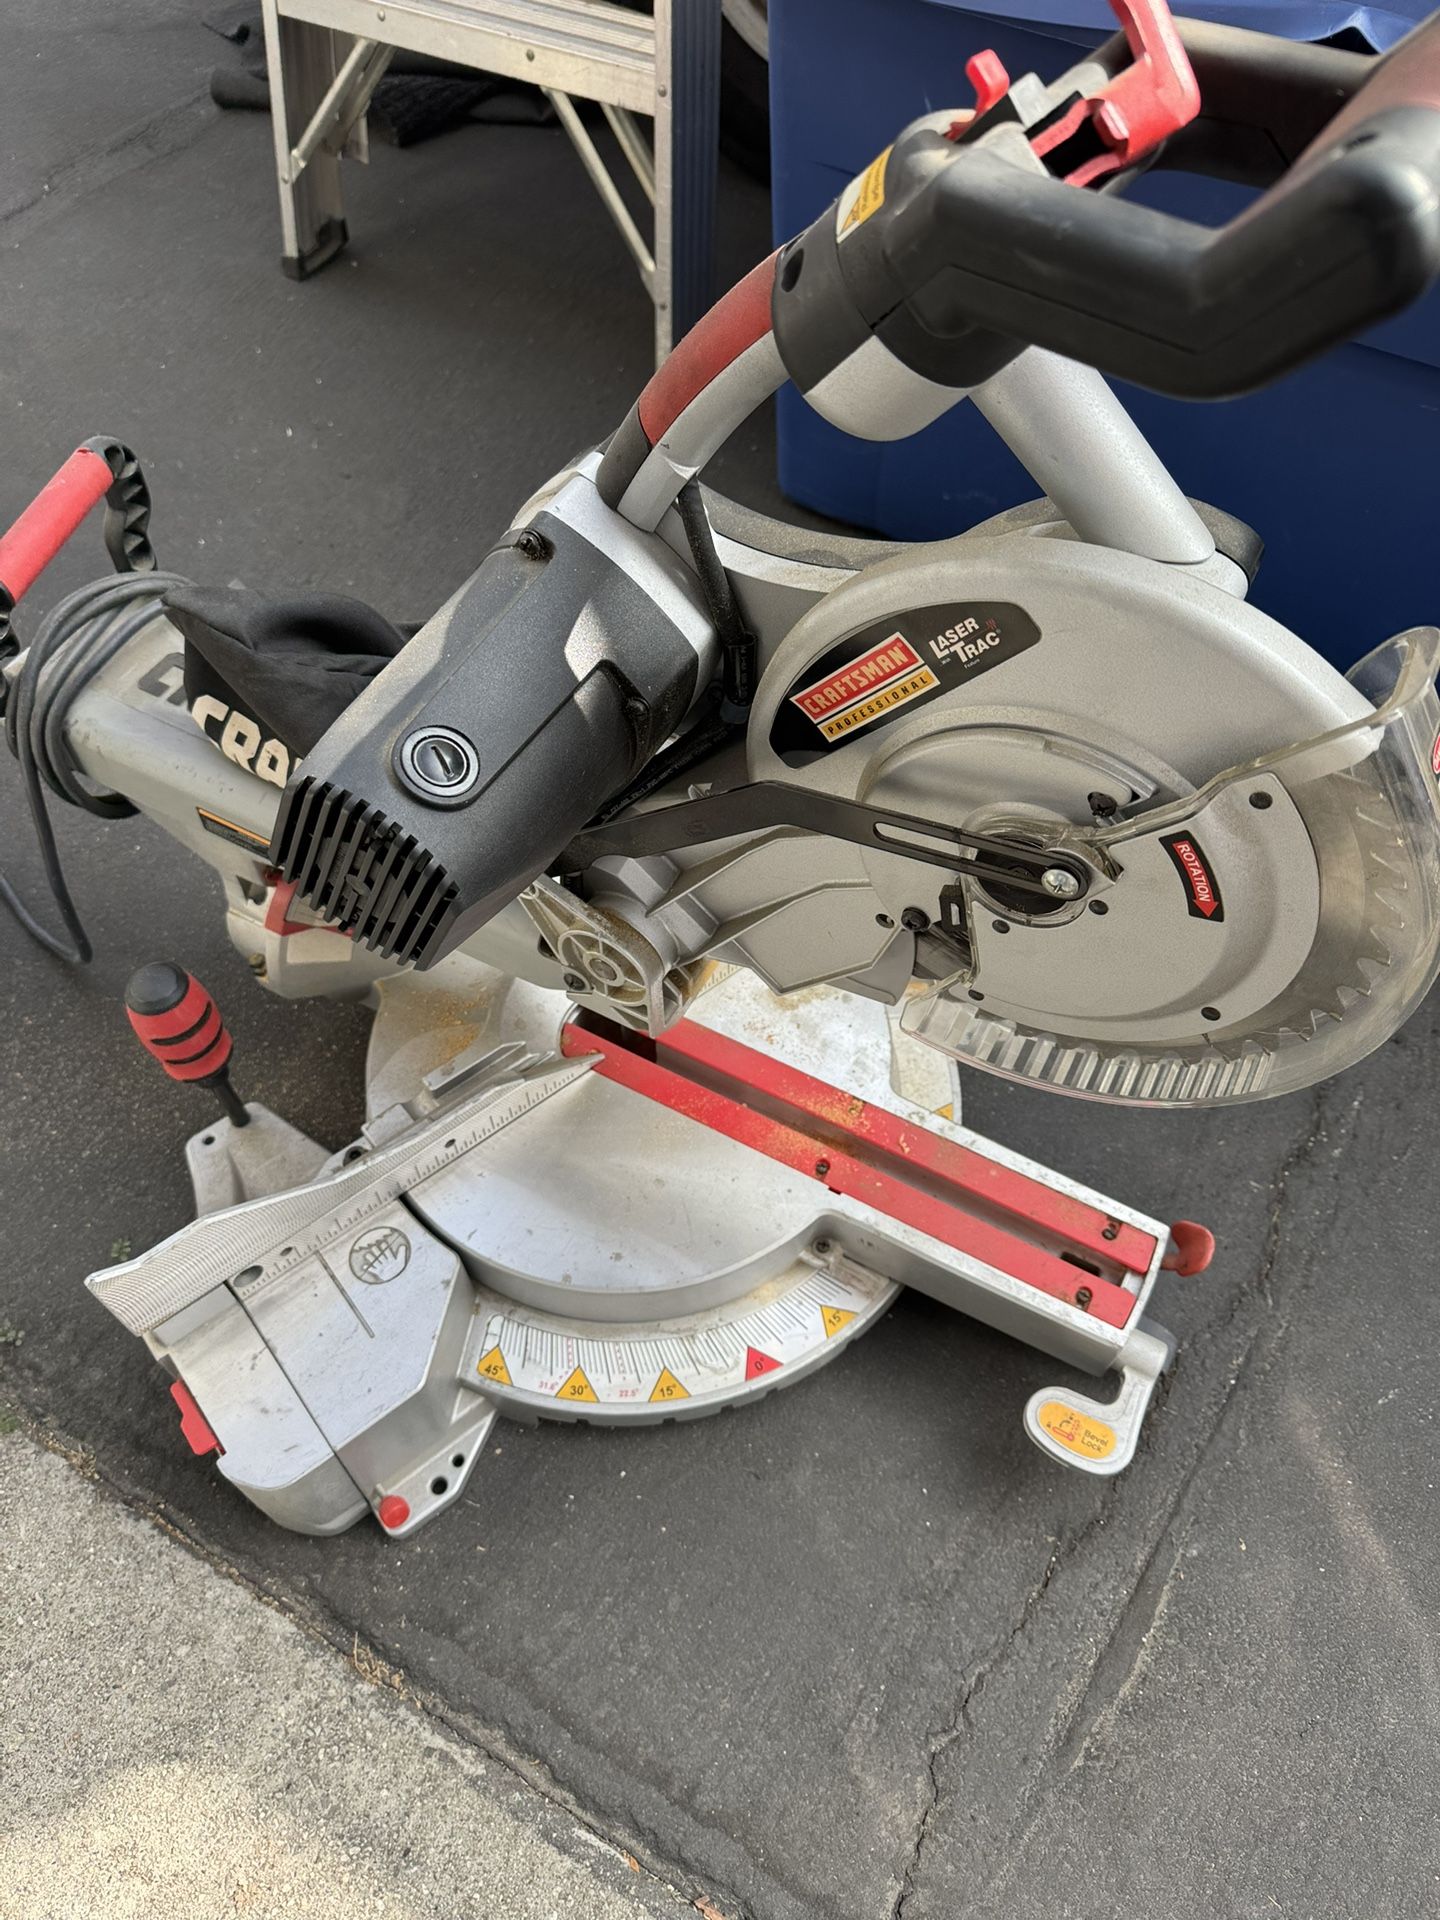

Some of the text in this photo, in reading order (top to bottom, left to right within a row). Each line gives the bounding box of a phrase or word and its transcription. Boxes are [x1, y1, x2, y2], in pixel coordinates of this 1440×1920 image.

[929, 617, 980, 659] LASER
[949, 632, 1000, 663] TRAC
[803, 646, 909, 714] CRAFTSMAN
[827, 676, 928, 734] PROFESSIONAL
[192, 694, 304, 789] CRA
[1176, 843, 1211, 902] ROTATION
[1081, 1436, 1102, 1453] Lock
[1084, 1429, 1109, 1447] Bevel
